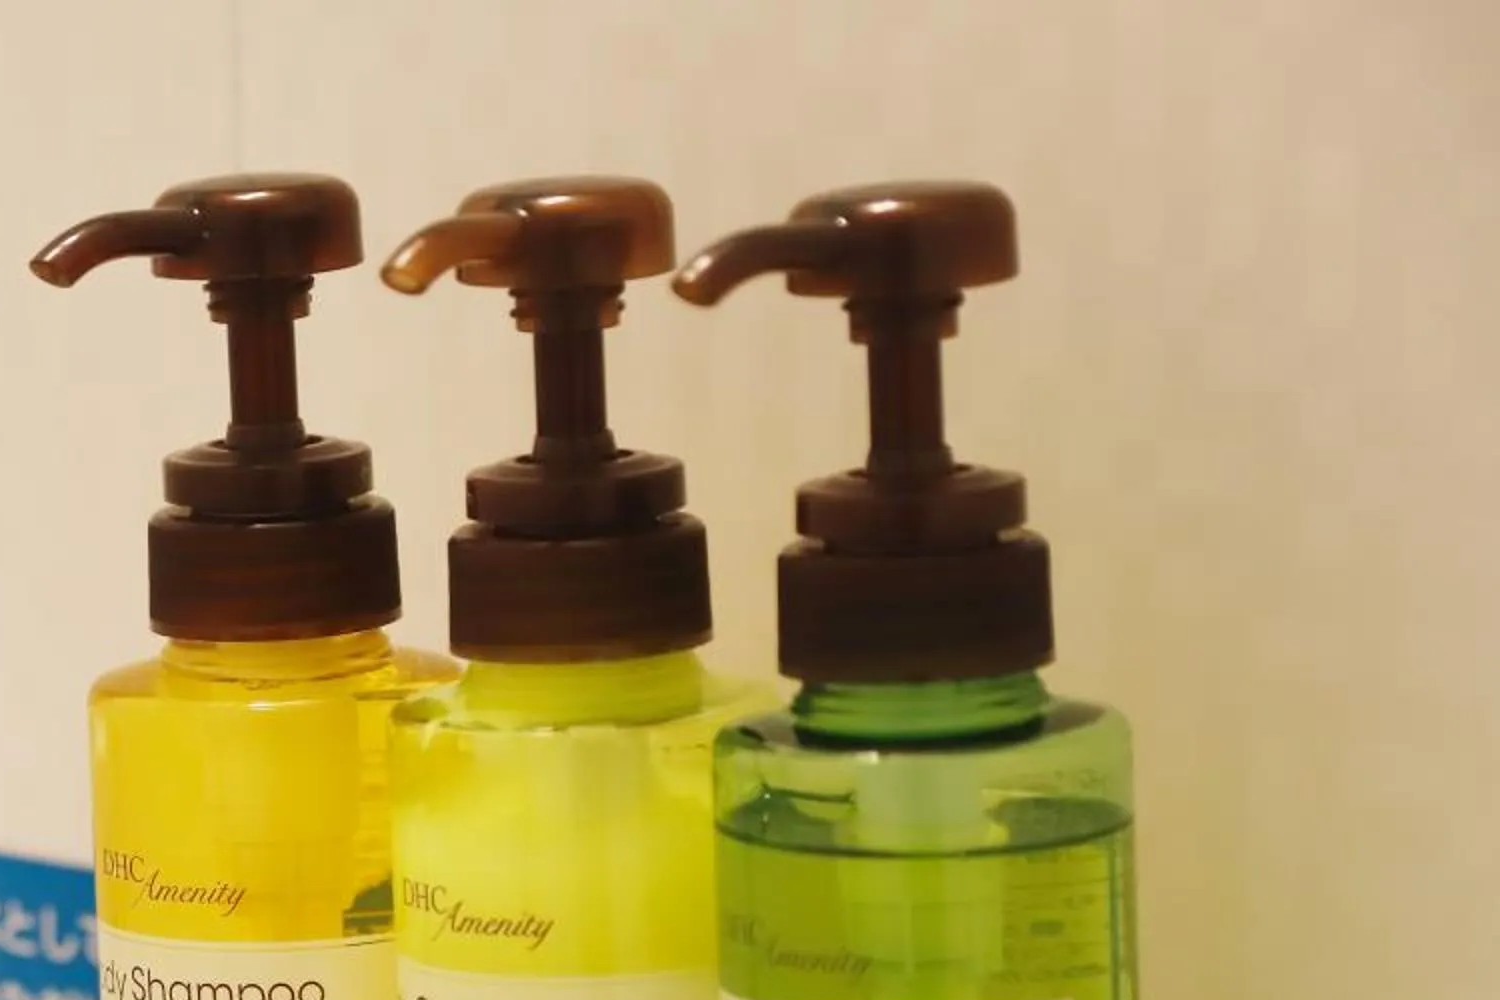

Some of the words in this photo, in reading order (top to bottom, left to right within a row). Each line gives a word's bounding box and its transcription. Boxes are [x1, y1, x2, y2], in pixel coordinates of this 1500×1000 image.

[103, 848, 145, 883] DHC
[132, 869, 247, 917] Amenity
[403, 877, 447, 914] DHC
[432, 900, 555, 951] Amenity
